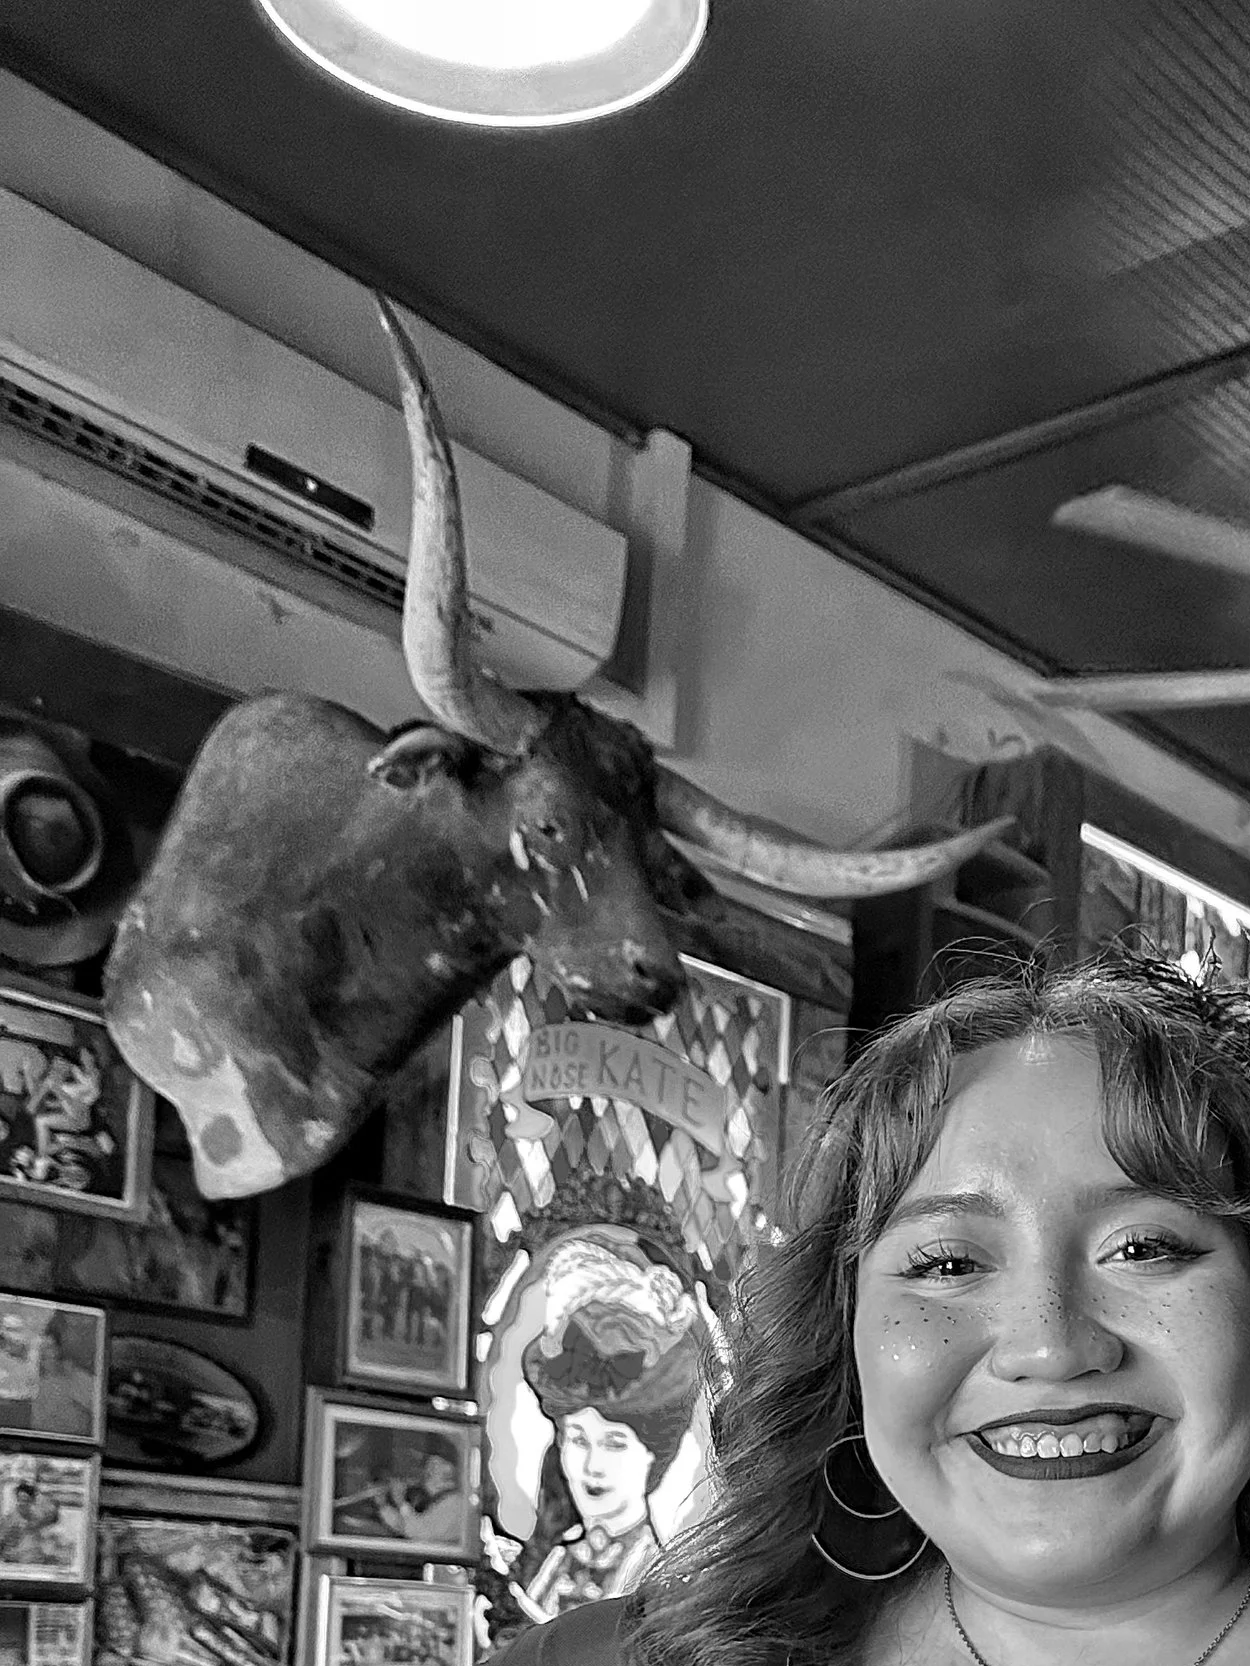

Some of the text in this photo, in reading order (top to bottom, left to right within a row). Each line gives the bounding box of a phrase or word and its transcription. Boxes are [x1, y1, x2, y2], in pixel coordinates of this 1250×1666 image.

[536, 1028, 579, 1057] BIG
[530, 1062, 589, 1090] NOSE
[600, 1039, 705, 1127] KATE
